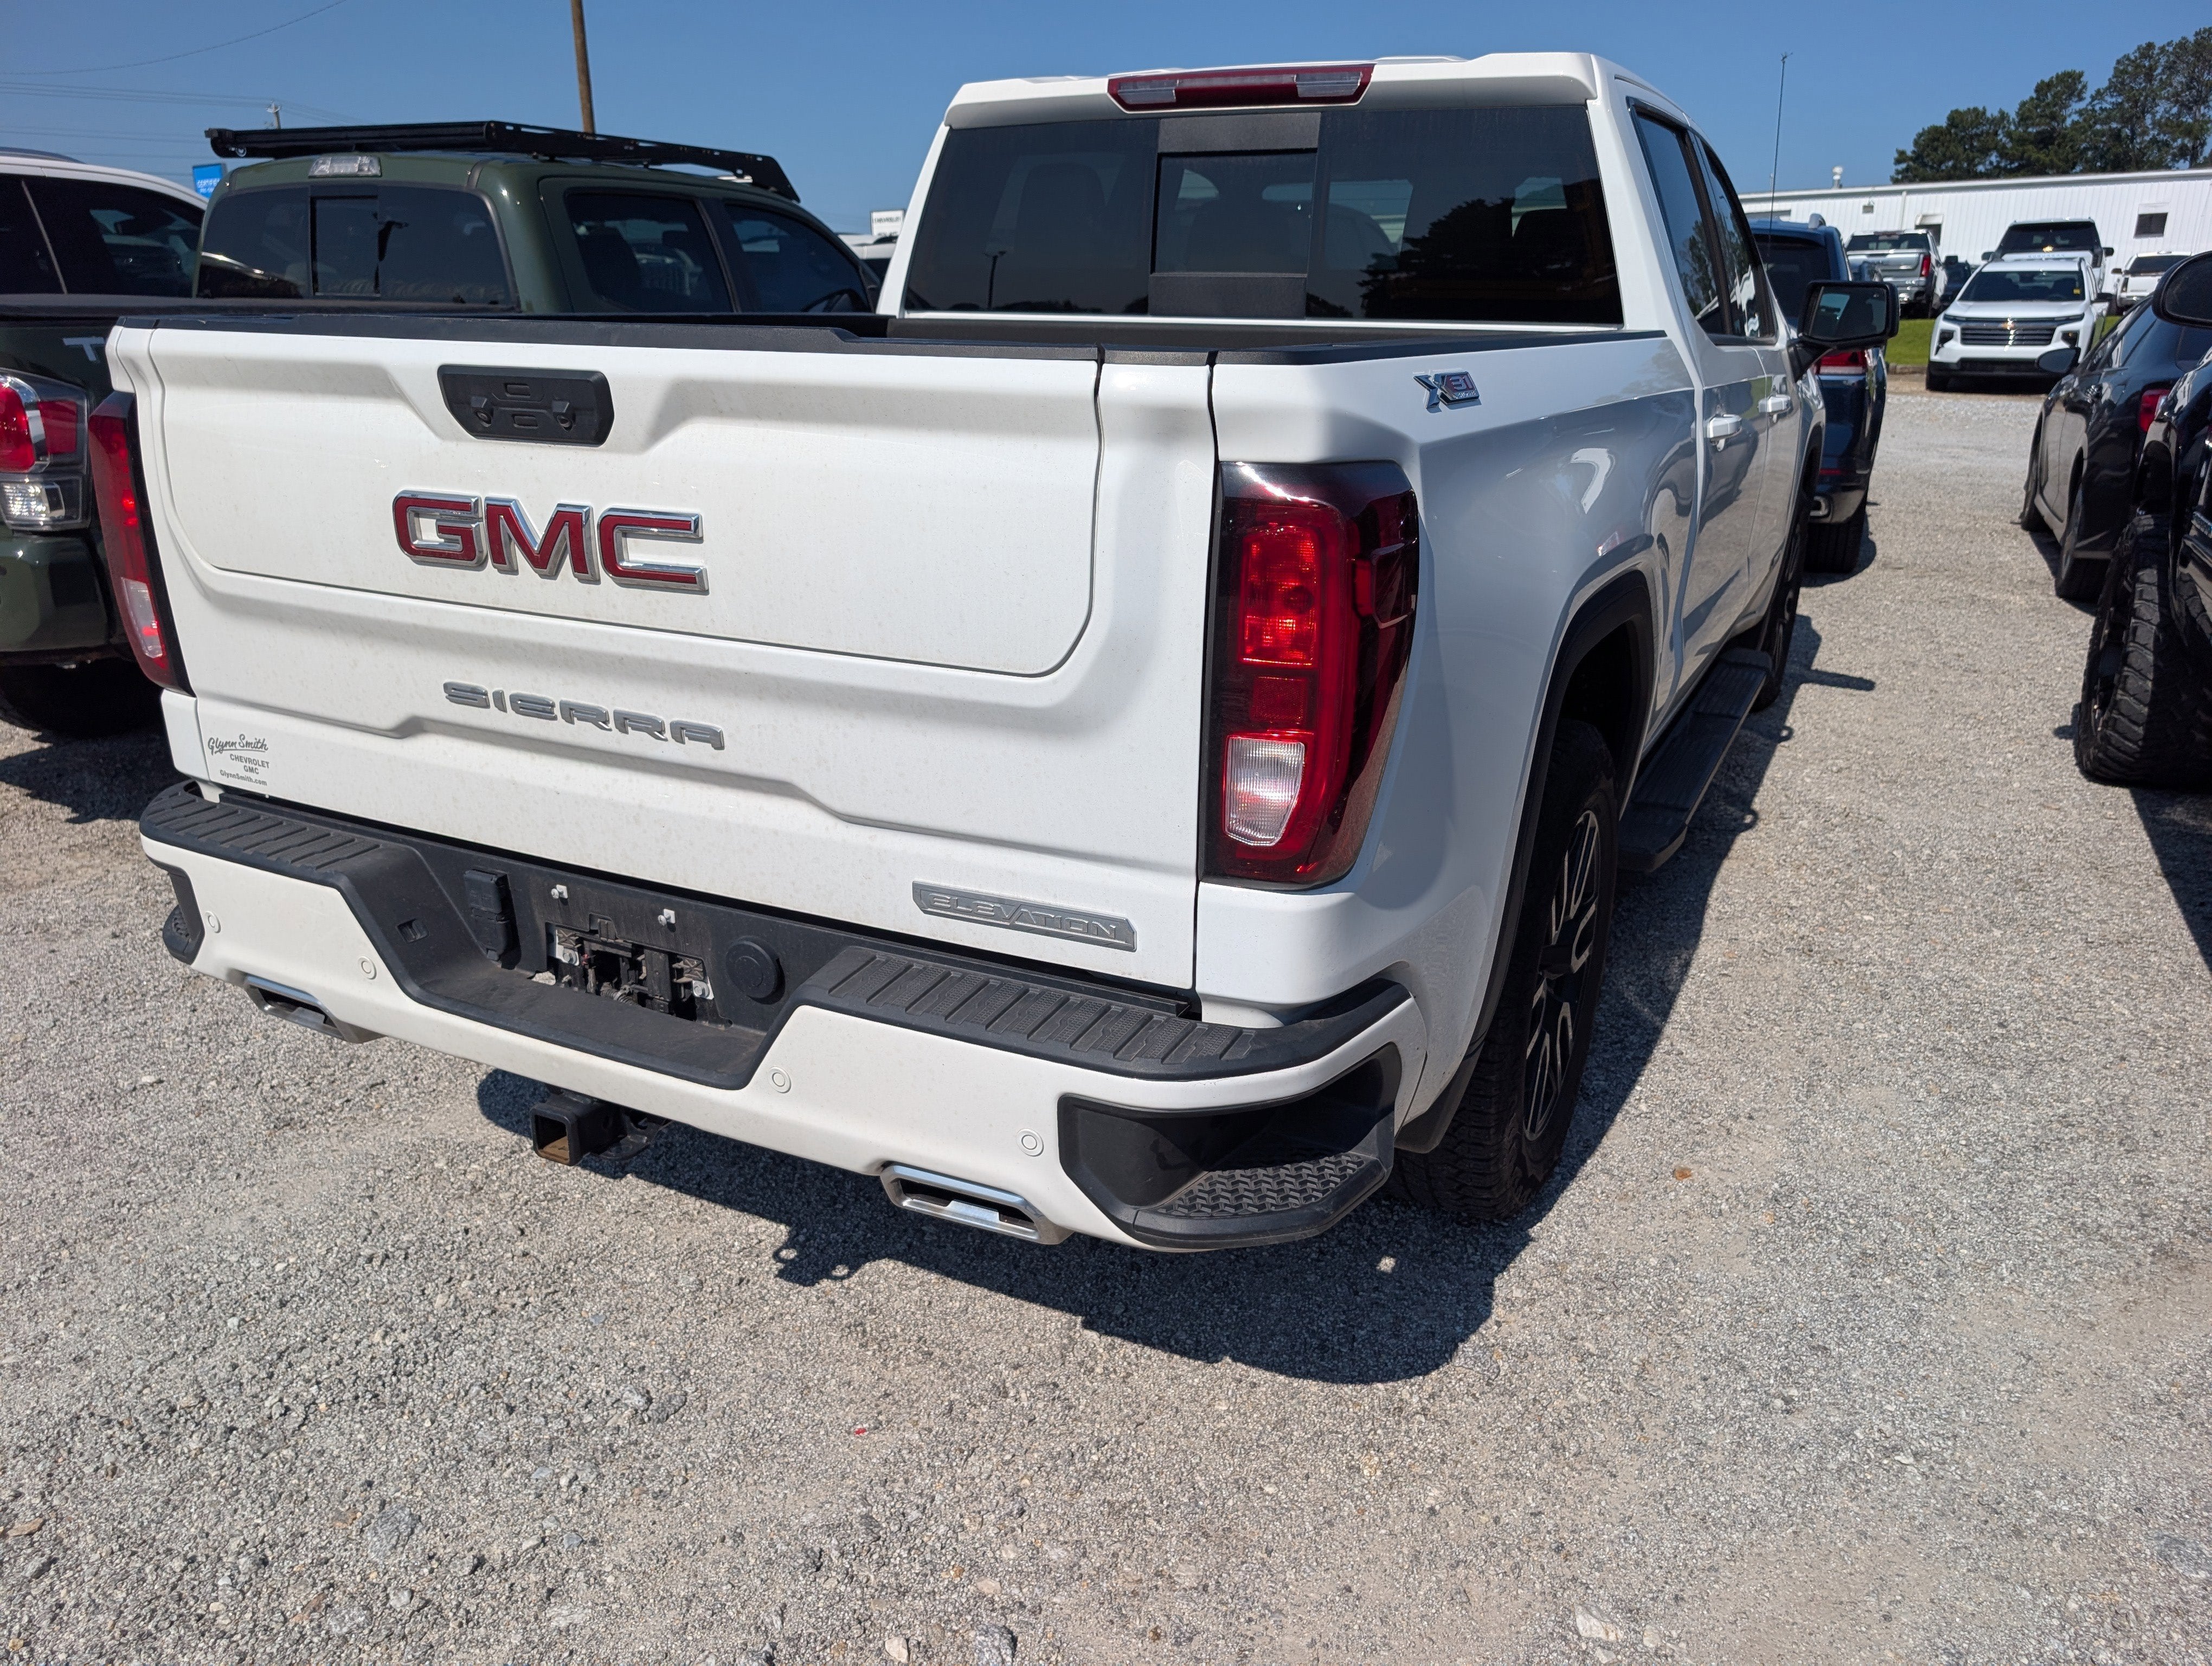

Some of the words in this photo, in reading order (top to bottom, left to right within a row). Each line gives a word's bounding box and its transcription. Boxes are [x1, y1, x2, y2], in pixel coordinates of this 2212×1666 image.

[393, 490, 709, 592] GMC
[442, 681, 725, 751] SIERRA
[208, 737, 237, 755] Glynn
[238, 733, 269, 752] Smith
[229, 753, 270, 769] CHEVROLET
[244, 765, 260, 775] GMC
[220, 769, 267, 786] GlynnSmith.com
[928, 893, 1117, 939] ELEVATION
